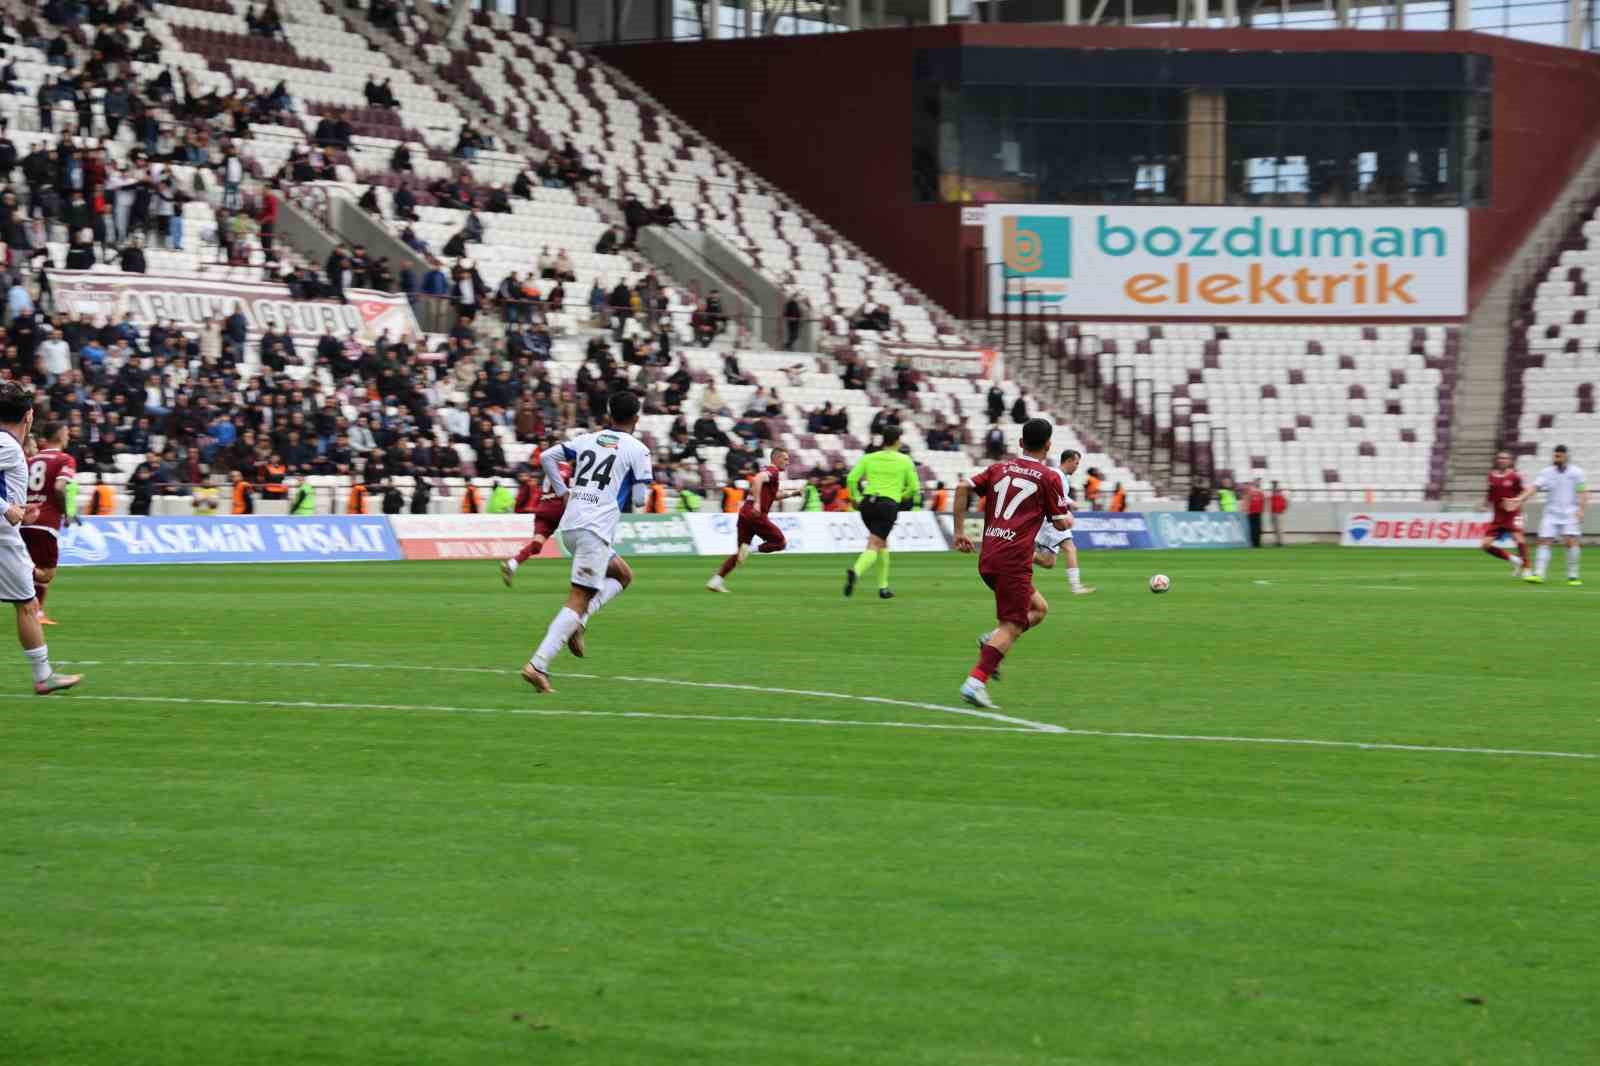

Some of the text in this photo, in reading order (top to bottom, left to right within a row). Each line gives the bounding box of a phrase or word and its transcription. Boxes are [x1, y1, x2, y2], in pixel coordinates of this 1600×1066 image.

[1097, 216, 1446, 258] bozduman
[1124, 263, 1416, 304] elektrik
[576, 450, 616, 490] 24
[994, 476, 1038, 520] 17
[108, 520, 267, 554] YASEMİN
[271, 523, 386, 554] İNŞAAT
[1372, 518, 1495, 541] DEĞİŞİM
